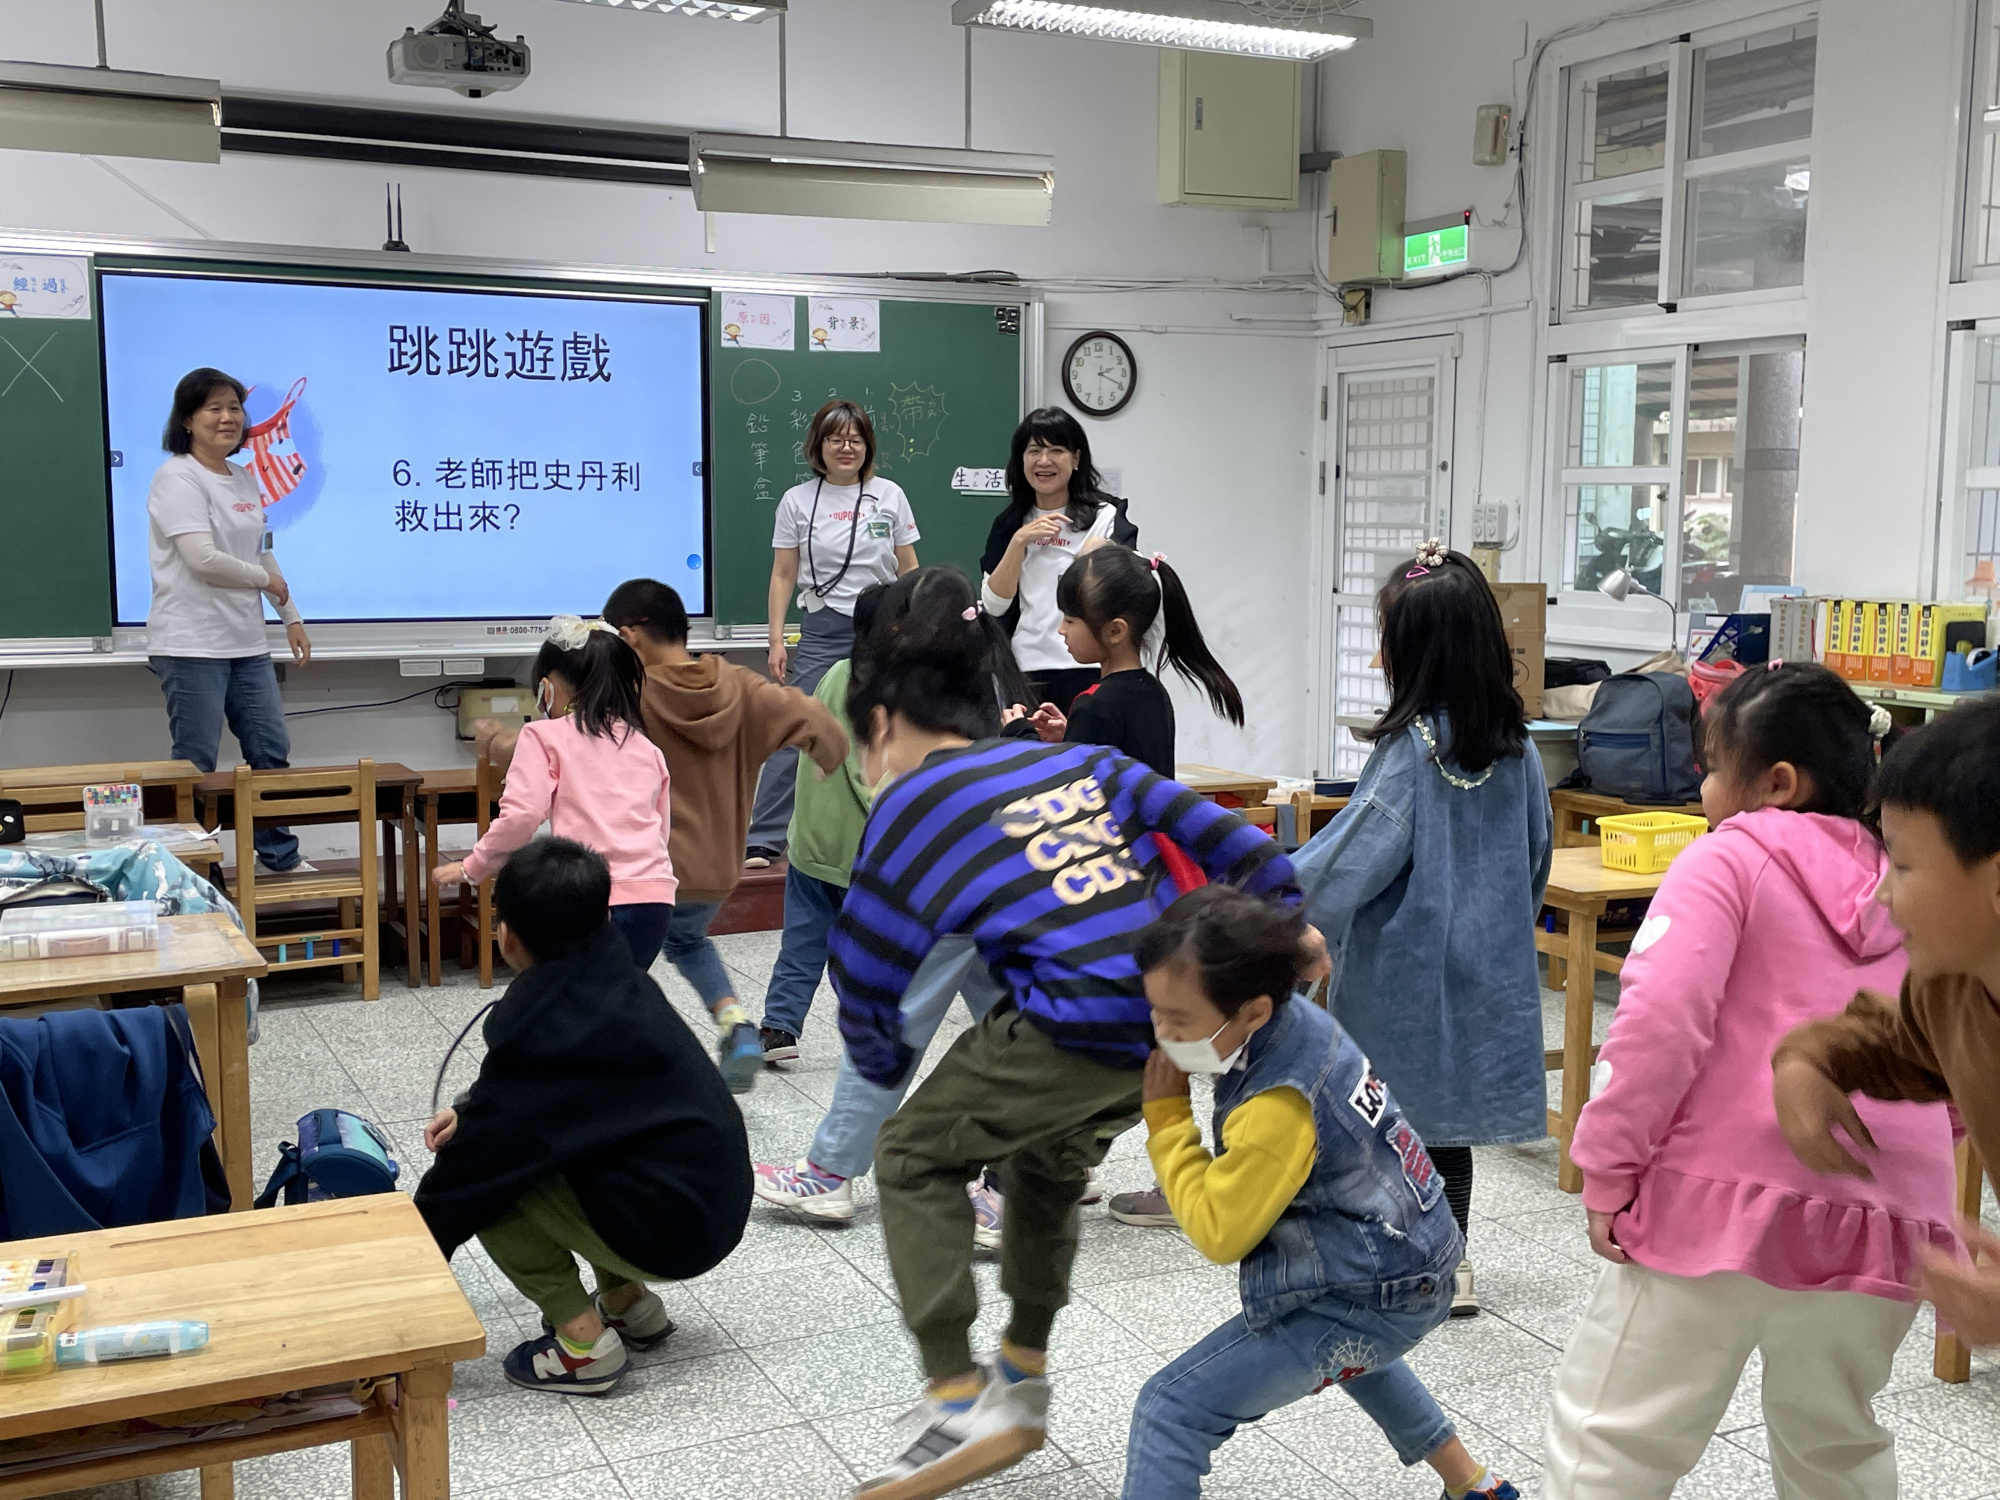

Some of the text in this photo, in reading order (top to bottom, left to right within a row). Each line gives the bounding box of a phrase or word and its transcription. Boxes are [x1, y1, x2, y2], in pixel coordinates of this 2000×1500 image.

[1407, 254, 1427, 265] EXIT
[13, 276, 59, 294] 經過
[737, 311, 770, 326] 原因
[827, 315, 860, 331] 背景
[388, 324, 612, 383] 跳跳遊戲
[791, 390, 802, 402] 3
[745, 412, 775, 500] 鉛筆盒
[392, 456, 640, 492] 6. 老師把史丹利
[952, 467, 1003, 489] 生活
[394, 498, 520, 533] 救出來?
